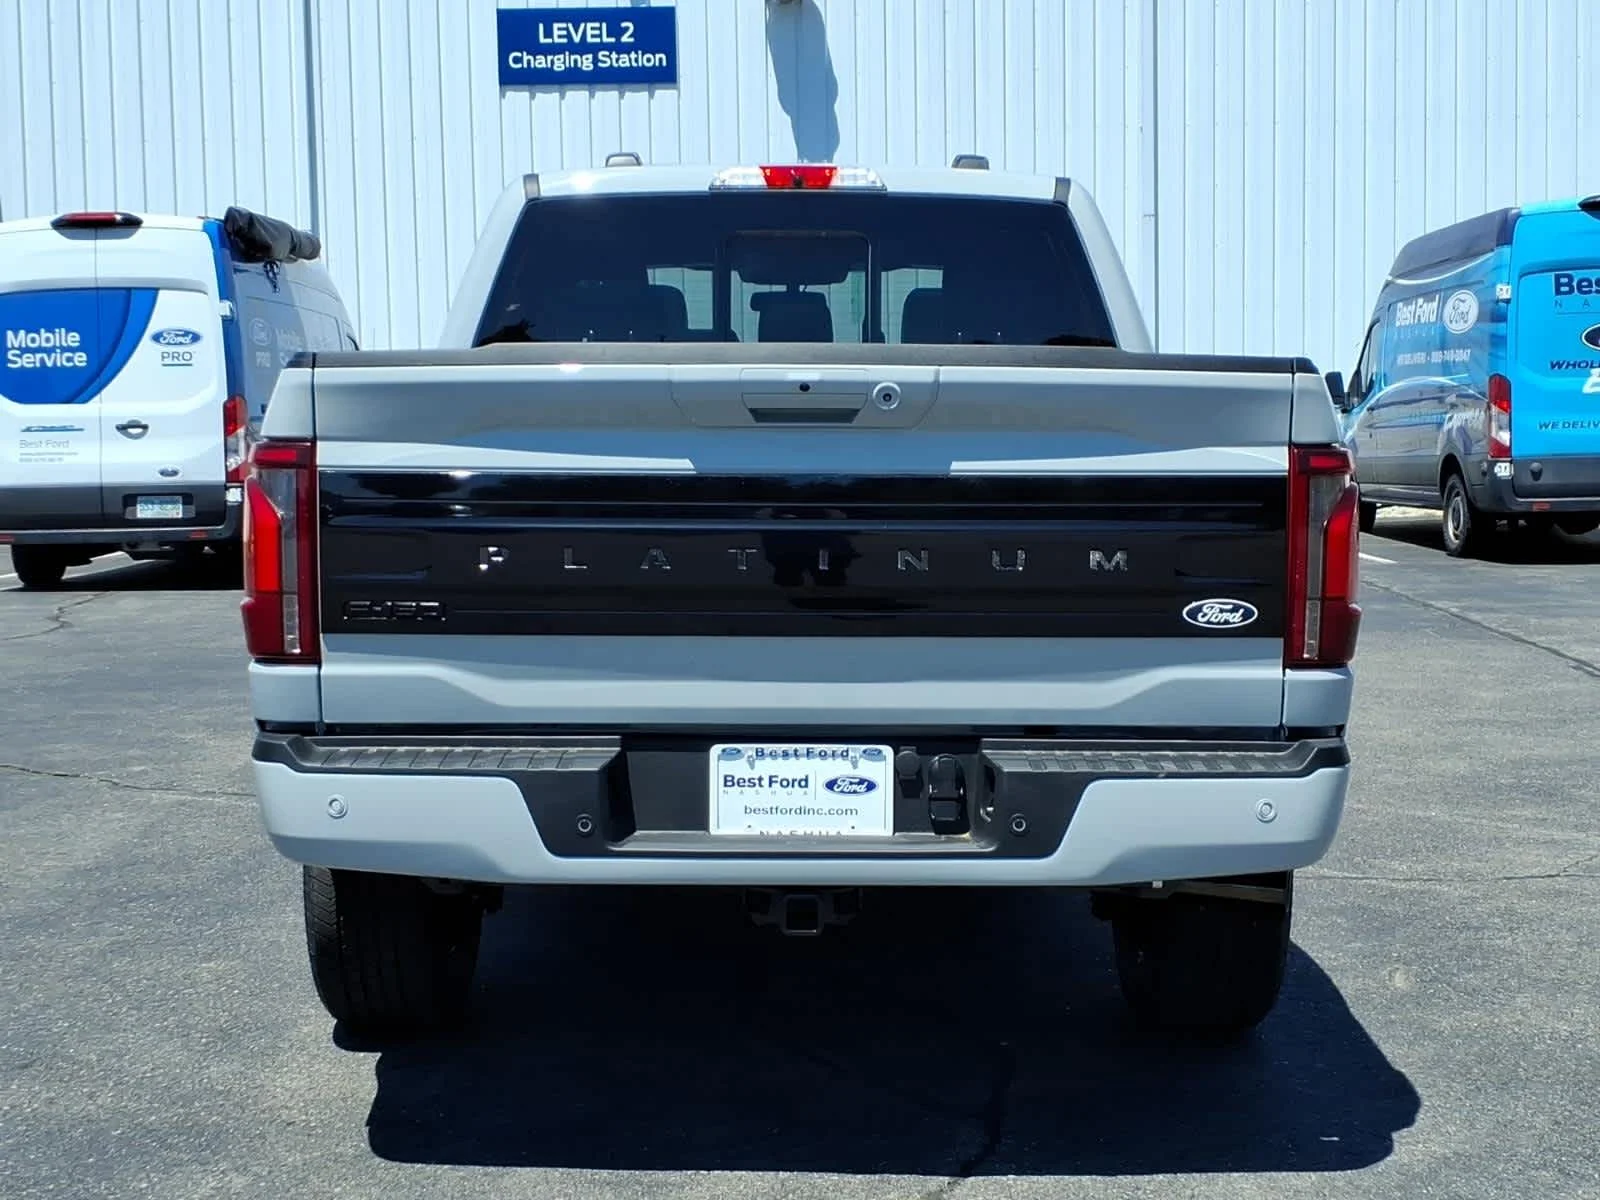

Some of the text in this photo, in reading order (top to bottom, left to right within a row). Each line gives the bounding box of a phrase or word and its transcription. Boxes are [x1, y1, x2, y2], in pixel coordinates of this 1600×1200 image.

[538, 21, 634, 44] LEVEL 2
[508, 50, 667, 71] Charging Station
[1415, 295, 1439, 324] Ford
[6, 326, 81, 348] Mobile
[159, 329, 193, 345] Ford
[6, 349, 88, 368] Service
[160, 351, 193, 362] PRO
[1550, 359, 1600, 370] WHOL
[1538, 420, 1560, 430] WE
[478, 546, 1129, 573] PLATINUM
[1197, 603, 1245, 623] Ford
[754, 746, 800, 759] Best
[806, 746, 850, 759] Ford
[722, 774, 809, 788] Best Ford
[832, 778, 867, 793] Ford
[744, 804, 859, 816] bestfordinc.com
